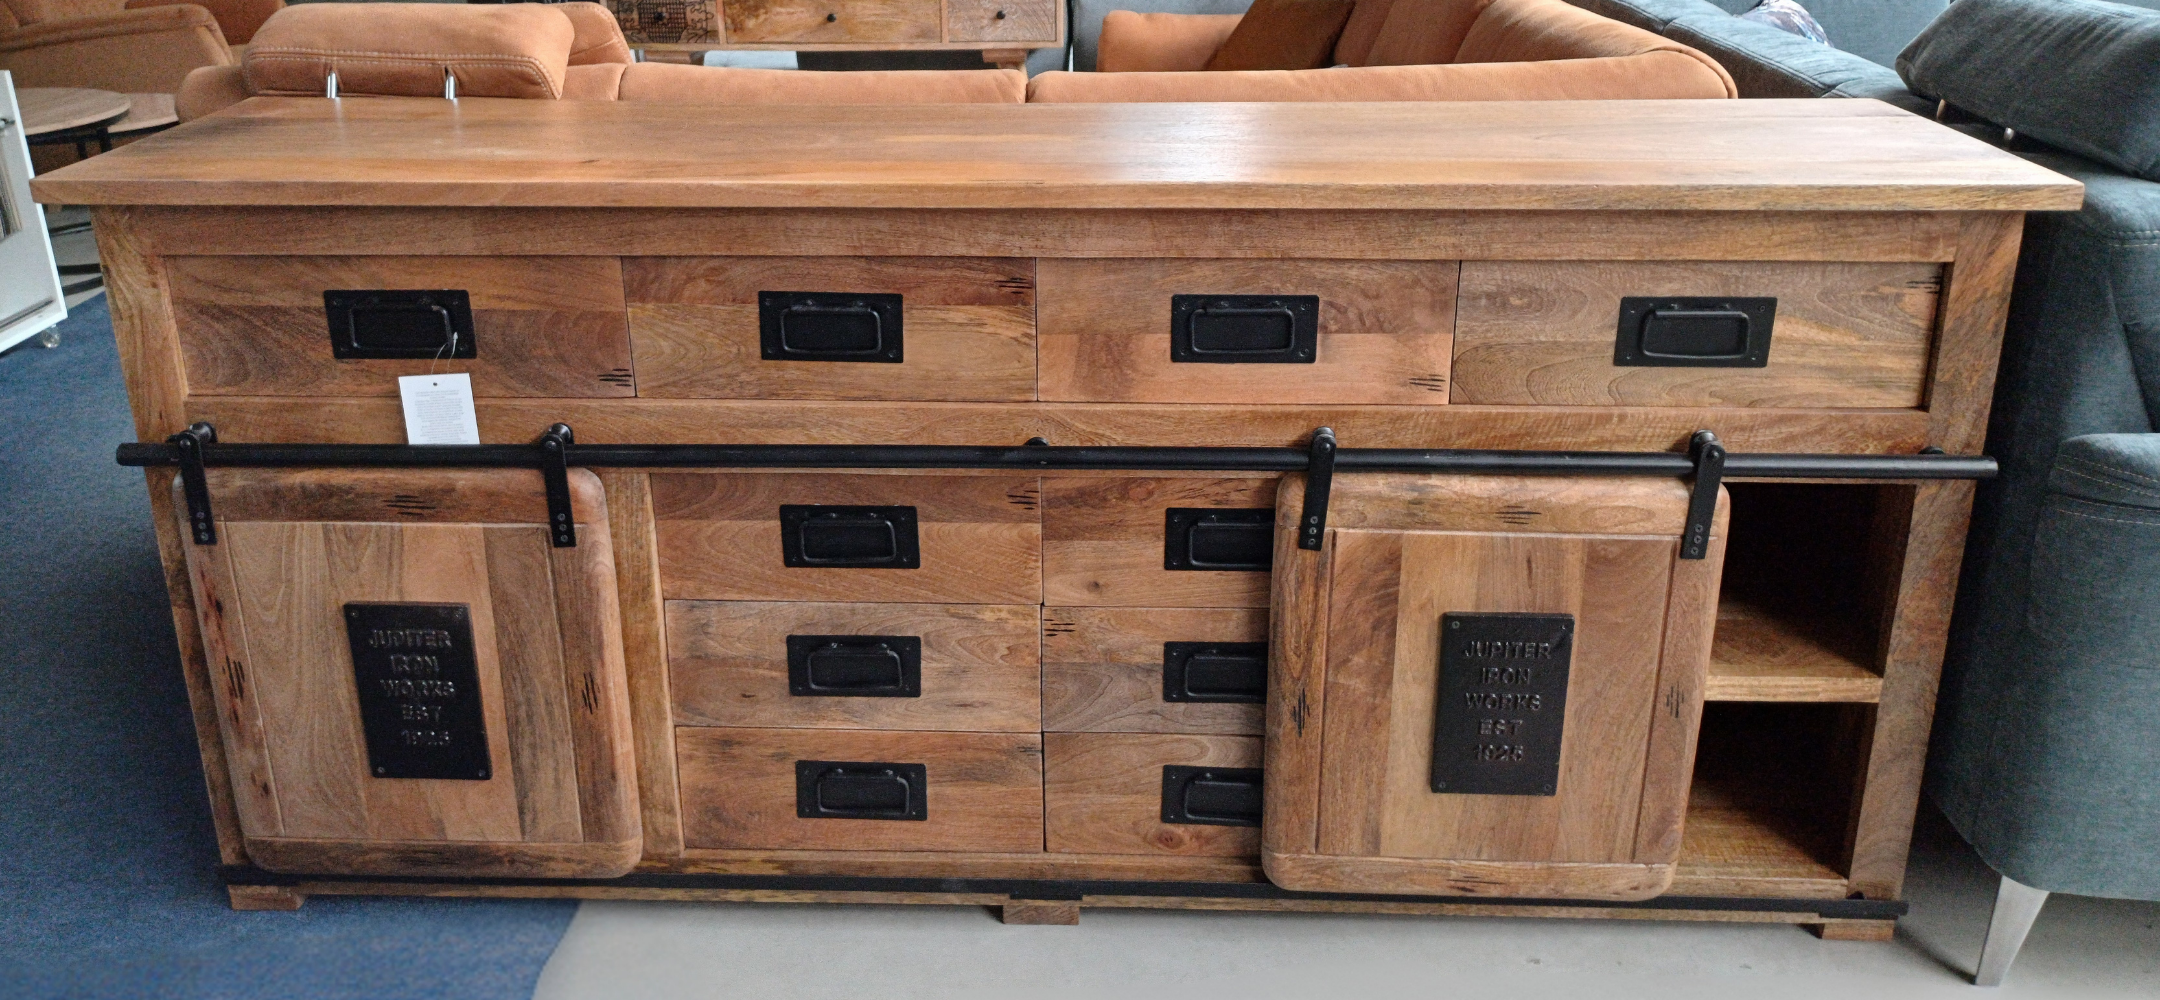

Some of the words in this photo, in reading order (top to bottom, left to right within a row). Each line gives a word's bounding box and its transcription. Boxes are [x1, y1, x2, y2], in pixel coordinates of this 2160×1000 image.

[368, 629, 452, 648] JUPITER
[1464, 641, 1551, 660] JUPITER
[390, 655, 439, 673] IRON
[1482, 667, 1530, 685] IRON
[380, 680, 455, 698] WORKS
[1465, 692, 1540, 711] WORKS
[402, 704, 441, 721] EST
[1480, 719, 1523, 736] EST
